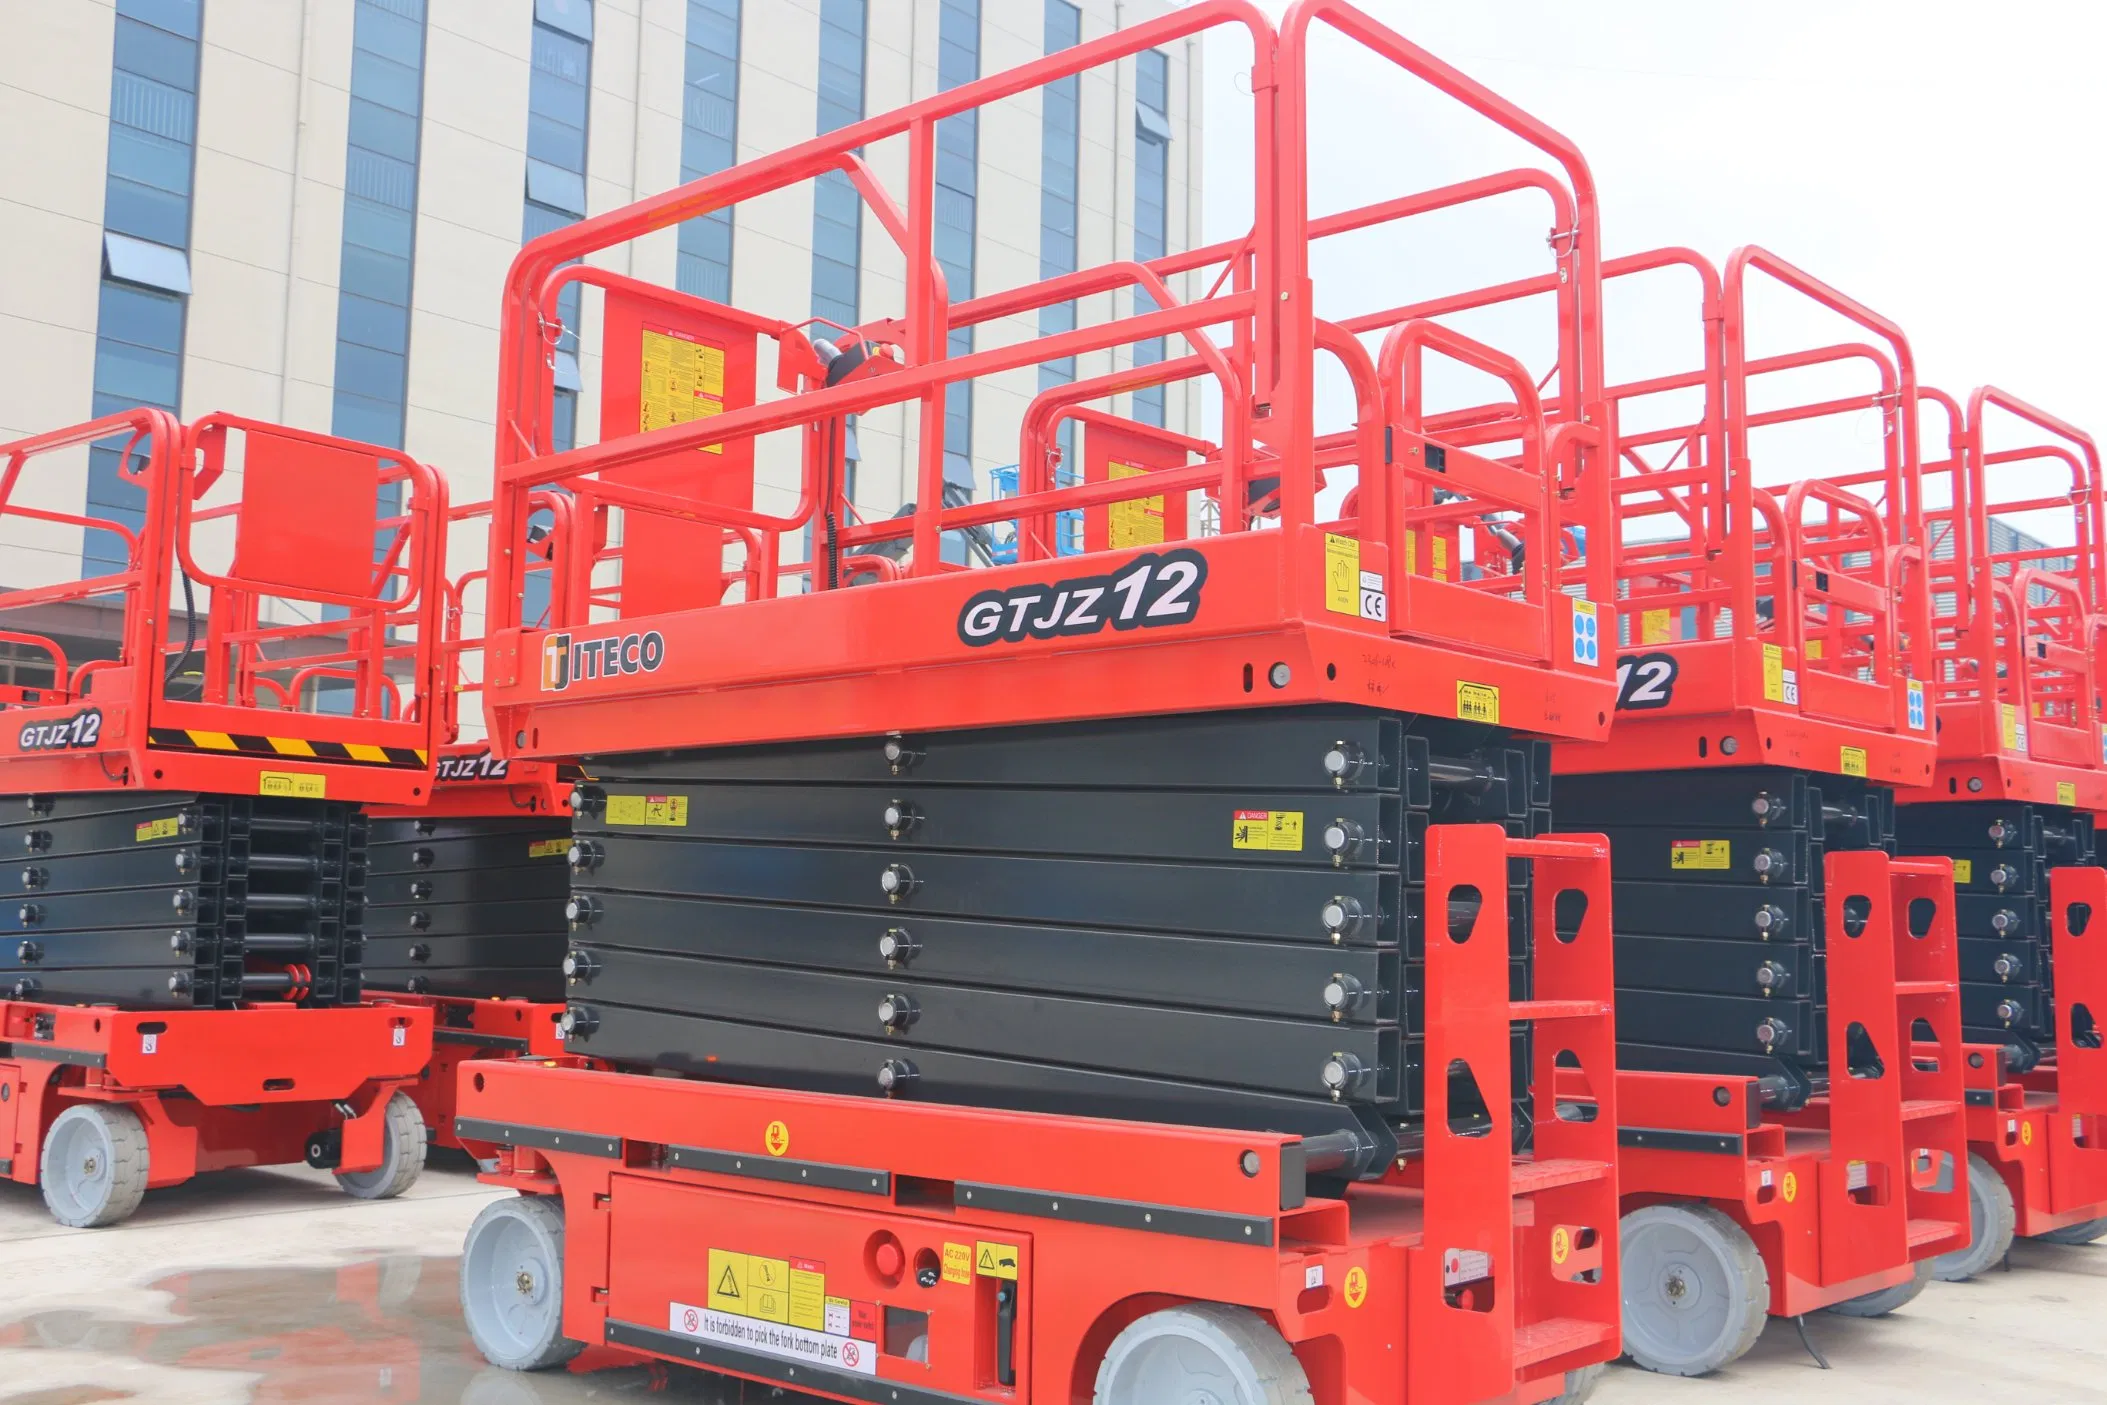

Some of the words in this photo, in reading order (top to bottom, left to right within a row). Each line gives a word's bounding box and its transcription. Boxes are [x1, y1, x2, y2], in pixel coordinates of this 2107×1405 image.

[704, 1314, 709, 1331] It
[710, 1316, 716, 1333] is
[716, 1318, 746, 1338] forbidden
[747, 1324, 754, 1340] to
[755, 1327, 768, 1345] pick
[769, 1330, 780, 1346] the
[780, 1333, 794, 1349] fork
[795, 1337, 820, 1354] bottom
[821, 1342, 838, 1359] plate
